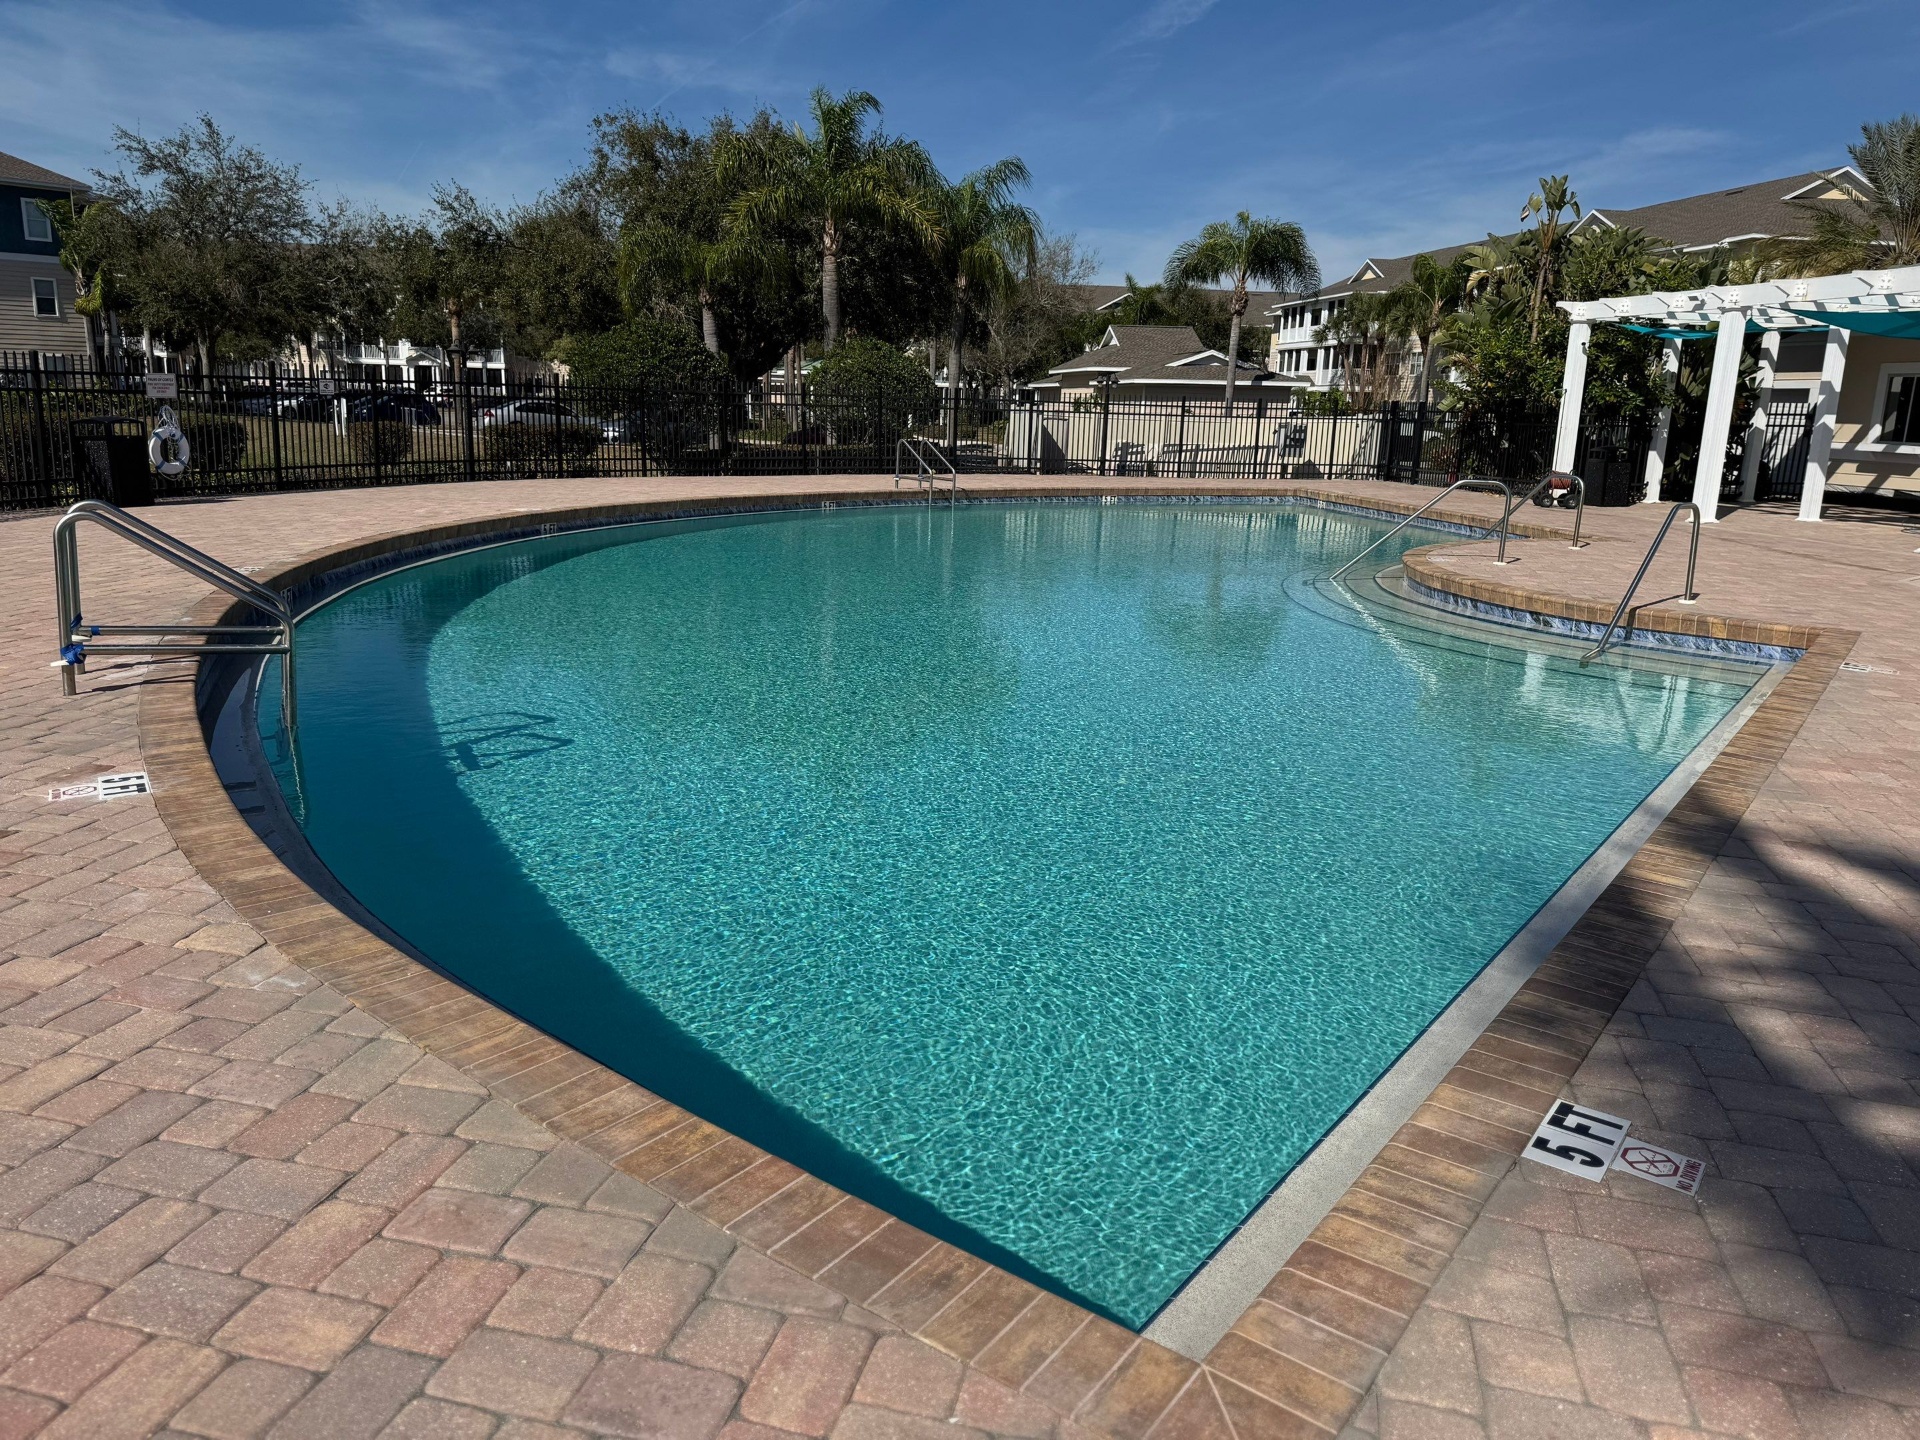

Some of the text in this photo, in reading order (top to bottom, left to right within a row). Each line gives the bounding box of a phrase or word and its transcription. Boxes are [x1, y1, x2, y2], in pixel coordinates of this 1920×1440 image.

[101, 775, 147, 796] 5 FT
[1531, 1101, 1624, 1168] 5 FT
[1675, 1159, 1702, 1193] NO DIVING
